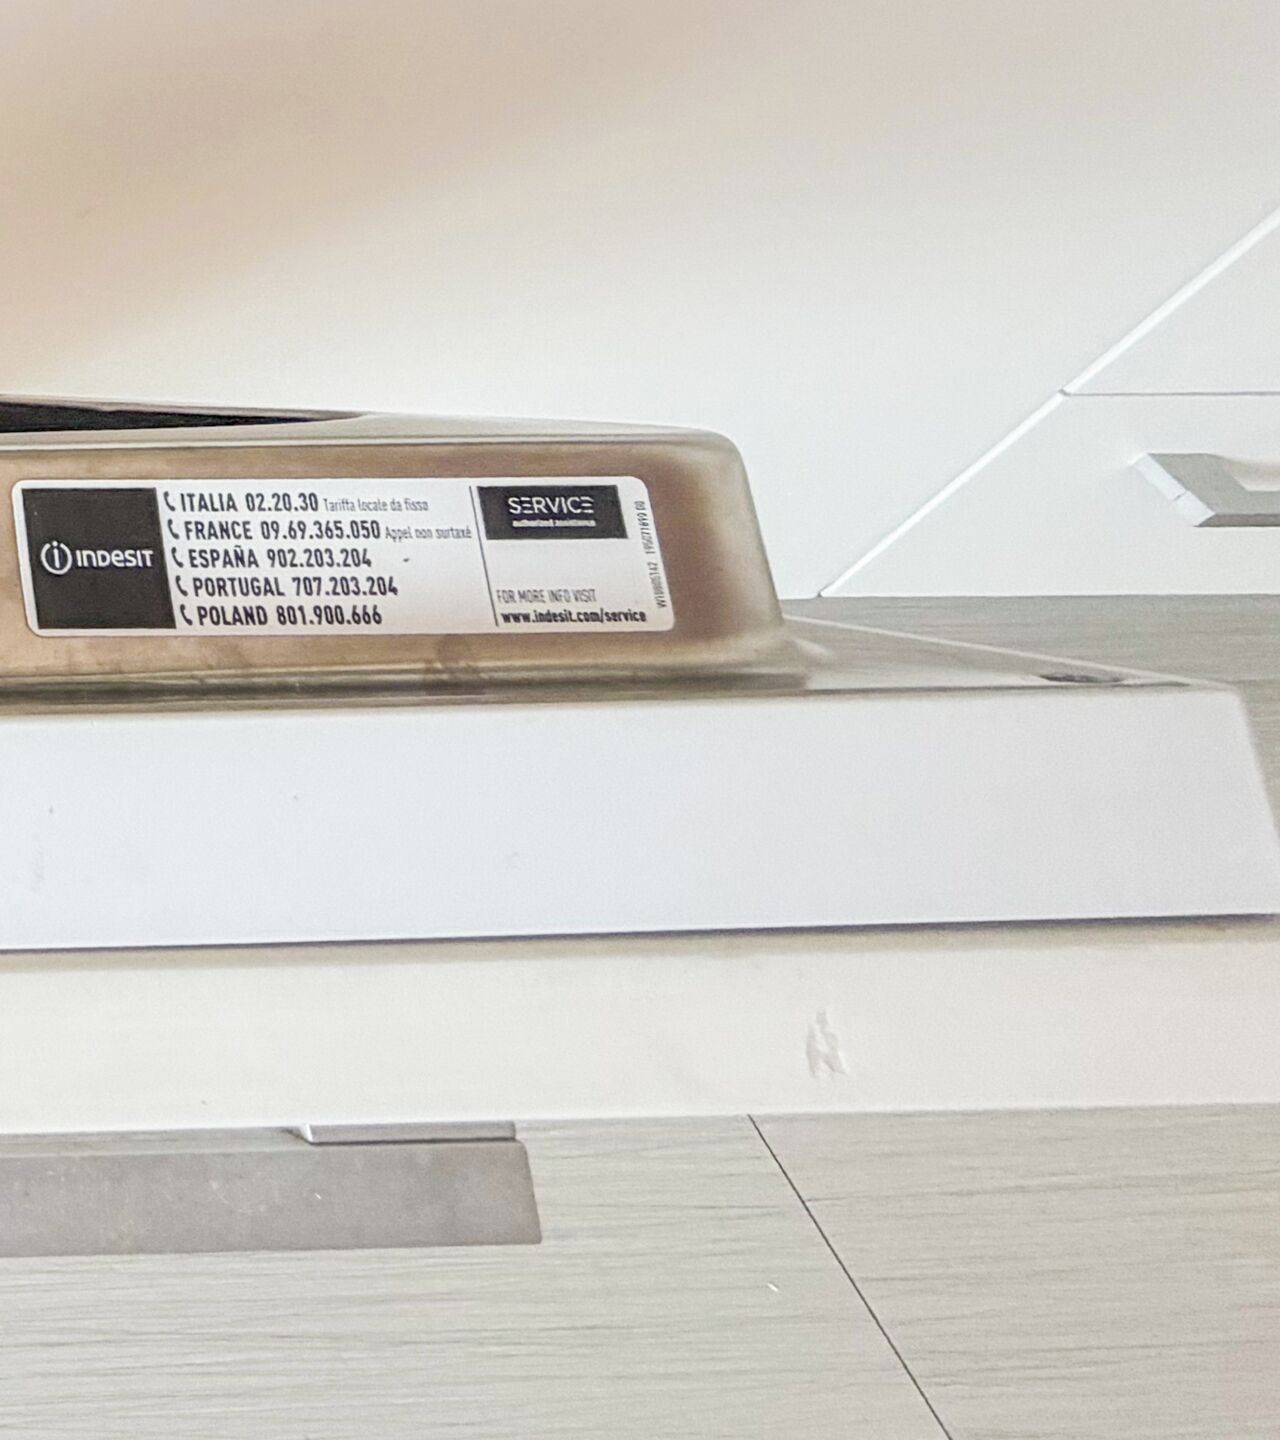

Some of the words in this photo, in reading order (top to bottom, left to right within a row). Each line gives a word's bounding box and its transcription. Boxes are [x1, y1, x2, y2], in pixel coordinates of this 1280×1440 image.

[180, 492, 238, 512] ITALIA
[246, 491, 319, 512] 02.20.30
[357, 498, 388, 512] locale
[390, 498, 403, 512] da
[507, 496, 595, 515] SERVICE
[185, 520, 253, 540] FRANCE
[260, 519, 381, 540] 09.69.365.050
[385, 526, 413, 543] Appel
[189, 545, 260, 568] ESPAÑA
[266, 546, 372, 568] 902.203.204
[193, 576, 286, 597] PORTUGAL
[291, 575, 399, 597] 707.203.204
[496, 589, 516, 604] FOR
[518, 589, 546, 604] MORE
[548, 589, 571, 603] INFO
[572, 589, 597, 603] VISIT
[198, 604, 268, 626] POLAND
[276, 604, 383, 627] 801.900.666
[500, 607, 648, 624] www.indesit.com/service
